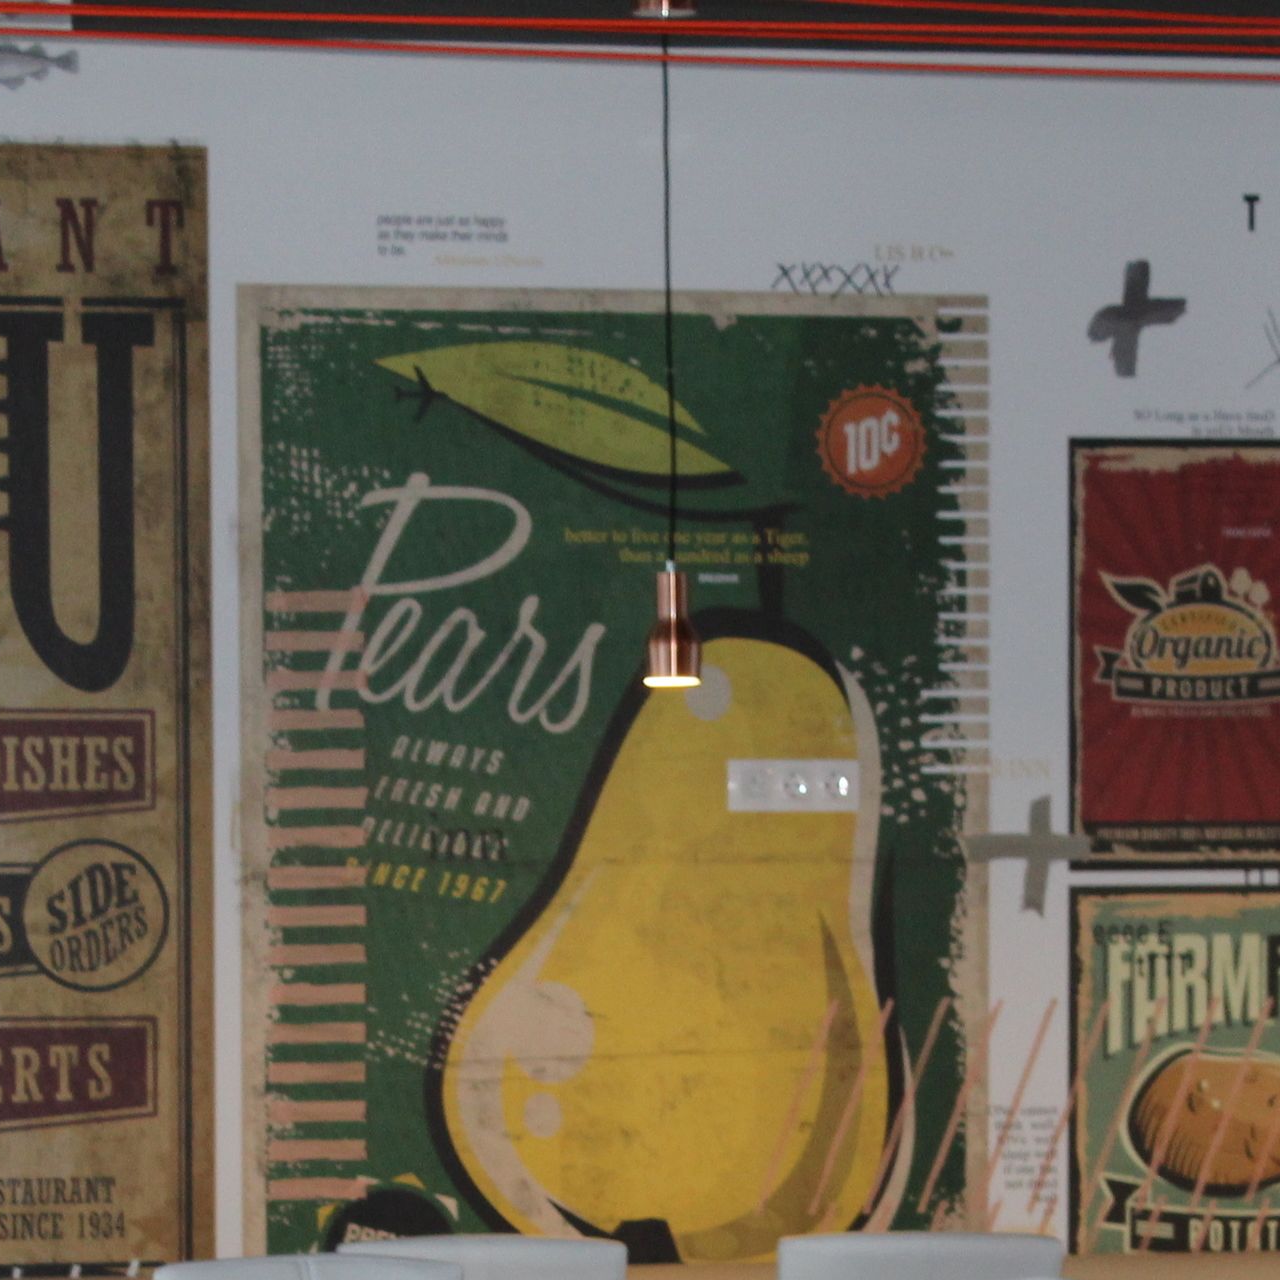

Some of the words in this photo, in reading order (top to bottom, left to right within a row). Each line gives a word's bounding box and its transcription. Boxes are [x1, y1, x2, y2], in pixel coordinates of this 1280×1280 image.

[845, 410, 901, 474] 10¢
[1135, 625, 1262, 670] Organic
[1150, 676, 1250, 700] PRODUCT
[390, 734, 505, 776] ALWAYS
[373, 776, 464, 812] FRESH
[473, 791, 531, 822] AND
[46, 861, 139, 938] SIDE
[437, 870, 508, 905] 1967
[48, 908, 151, 977] ORDERS
[76, 1209, 127, 1239] 1934
